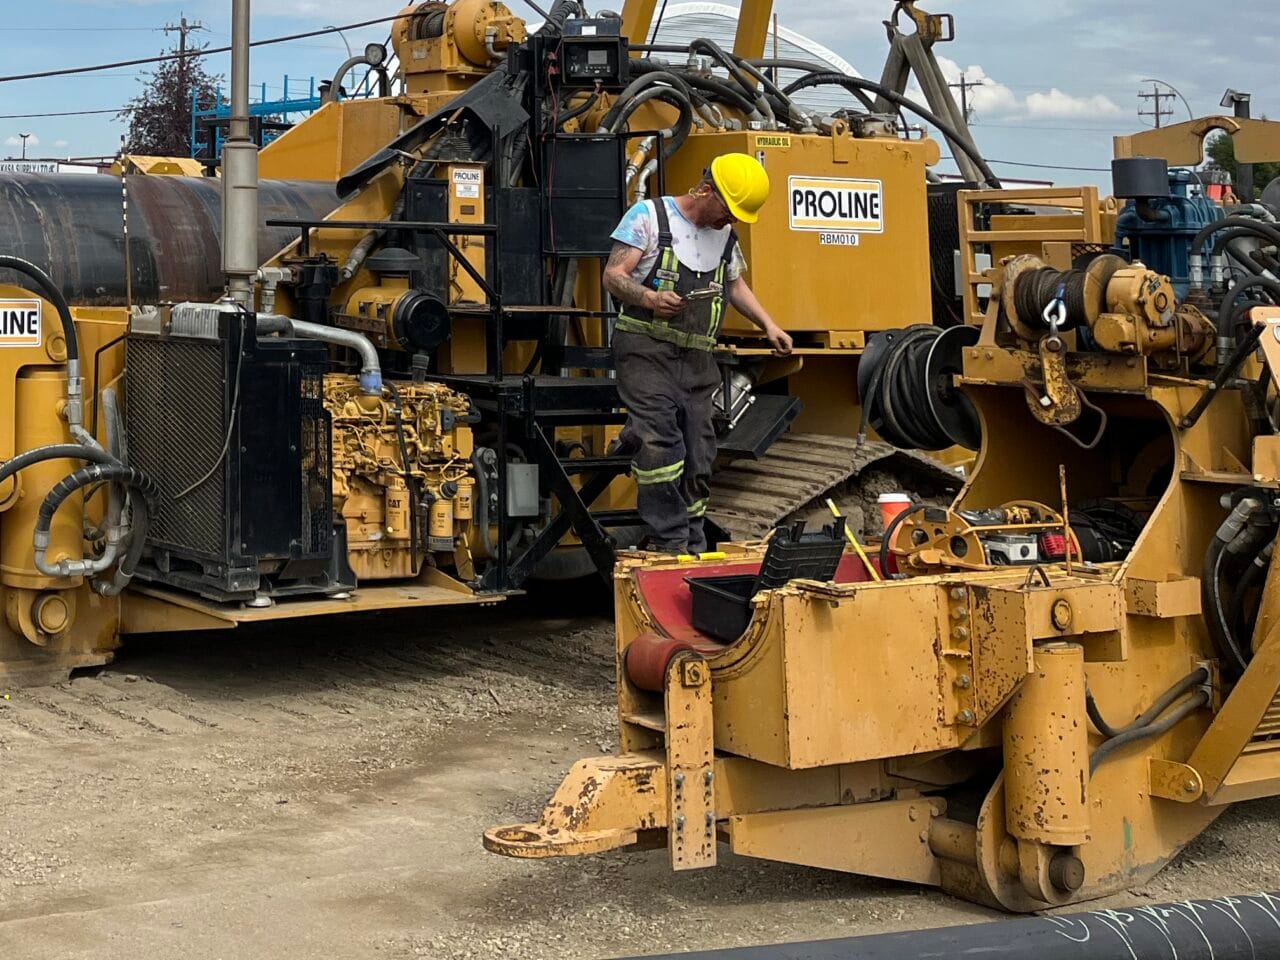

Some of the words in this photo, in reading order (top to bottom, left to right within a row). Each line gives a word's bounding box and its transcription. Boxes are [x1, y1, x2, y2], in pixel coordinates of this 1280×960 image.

[757, 136, 782, 146] HYDRAULIC
[454, 172, 480, 181] PROLINE
[792, 189, 880, 219] PROLINE
[820, 233, 857, 245] RBM010
[387, 499, 402, 509] CAT
